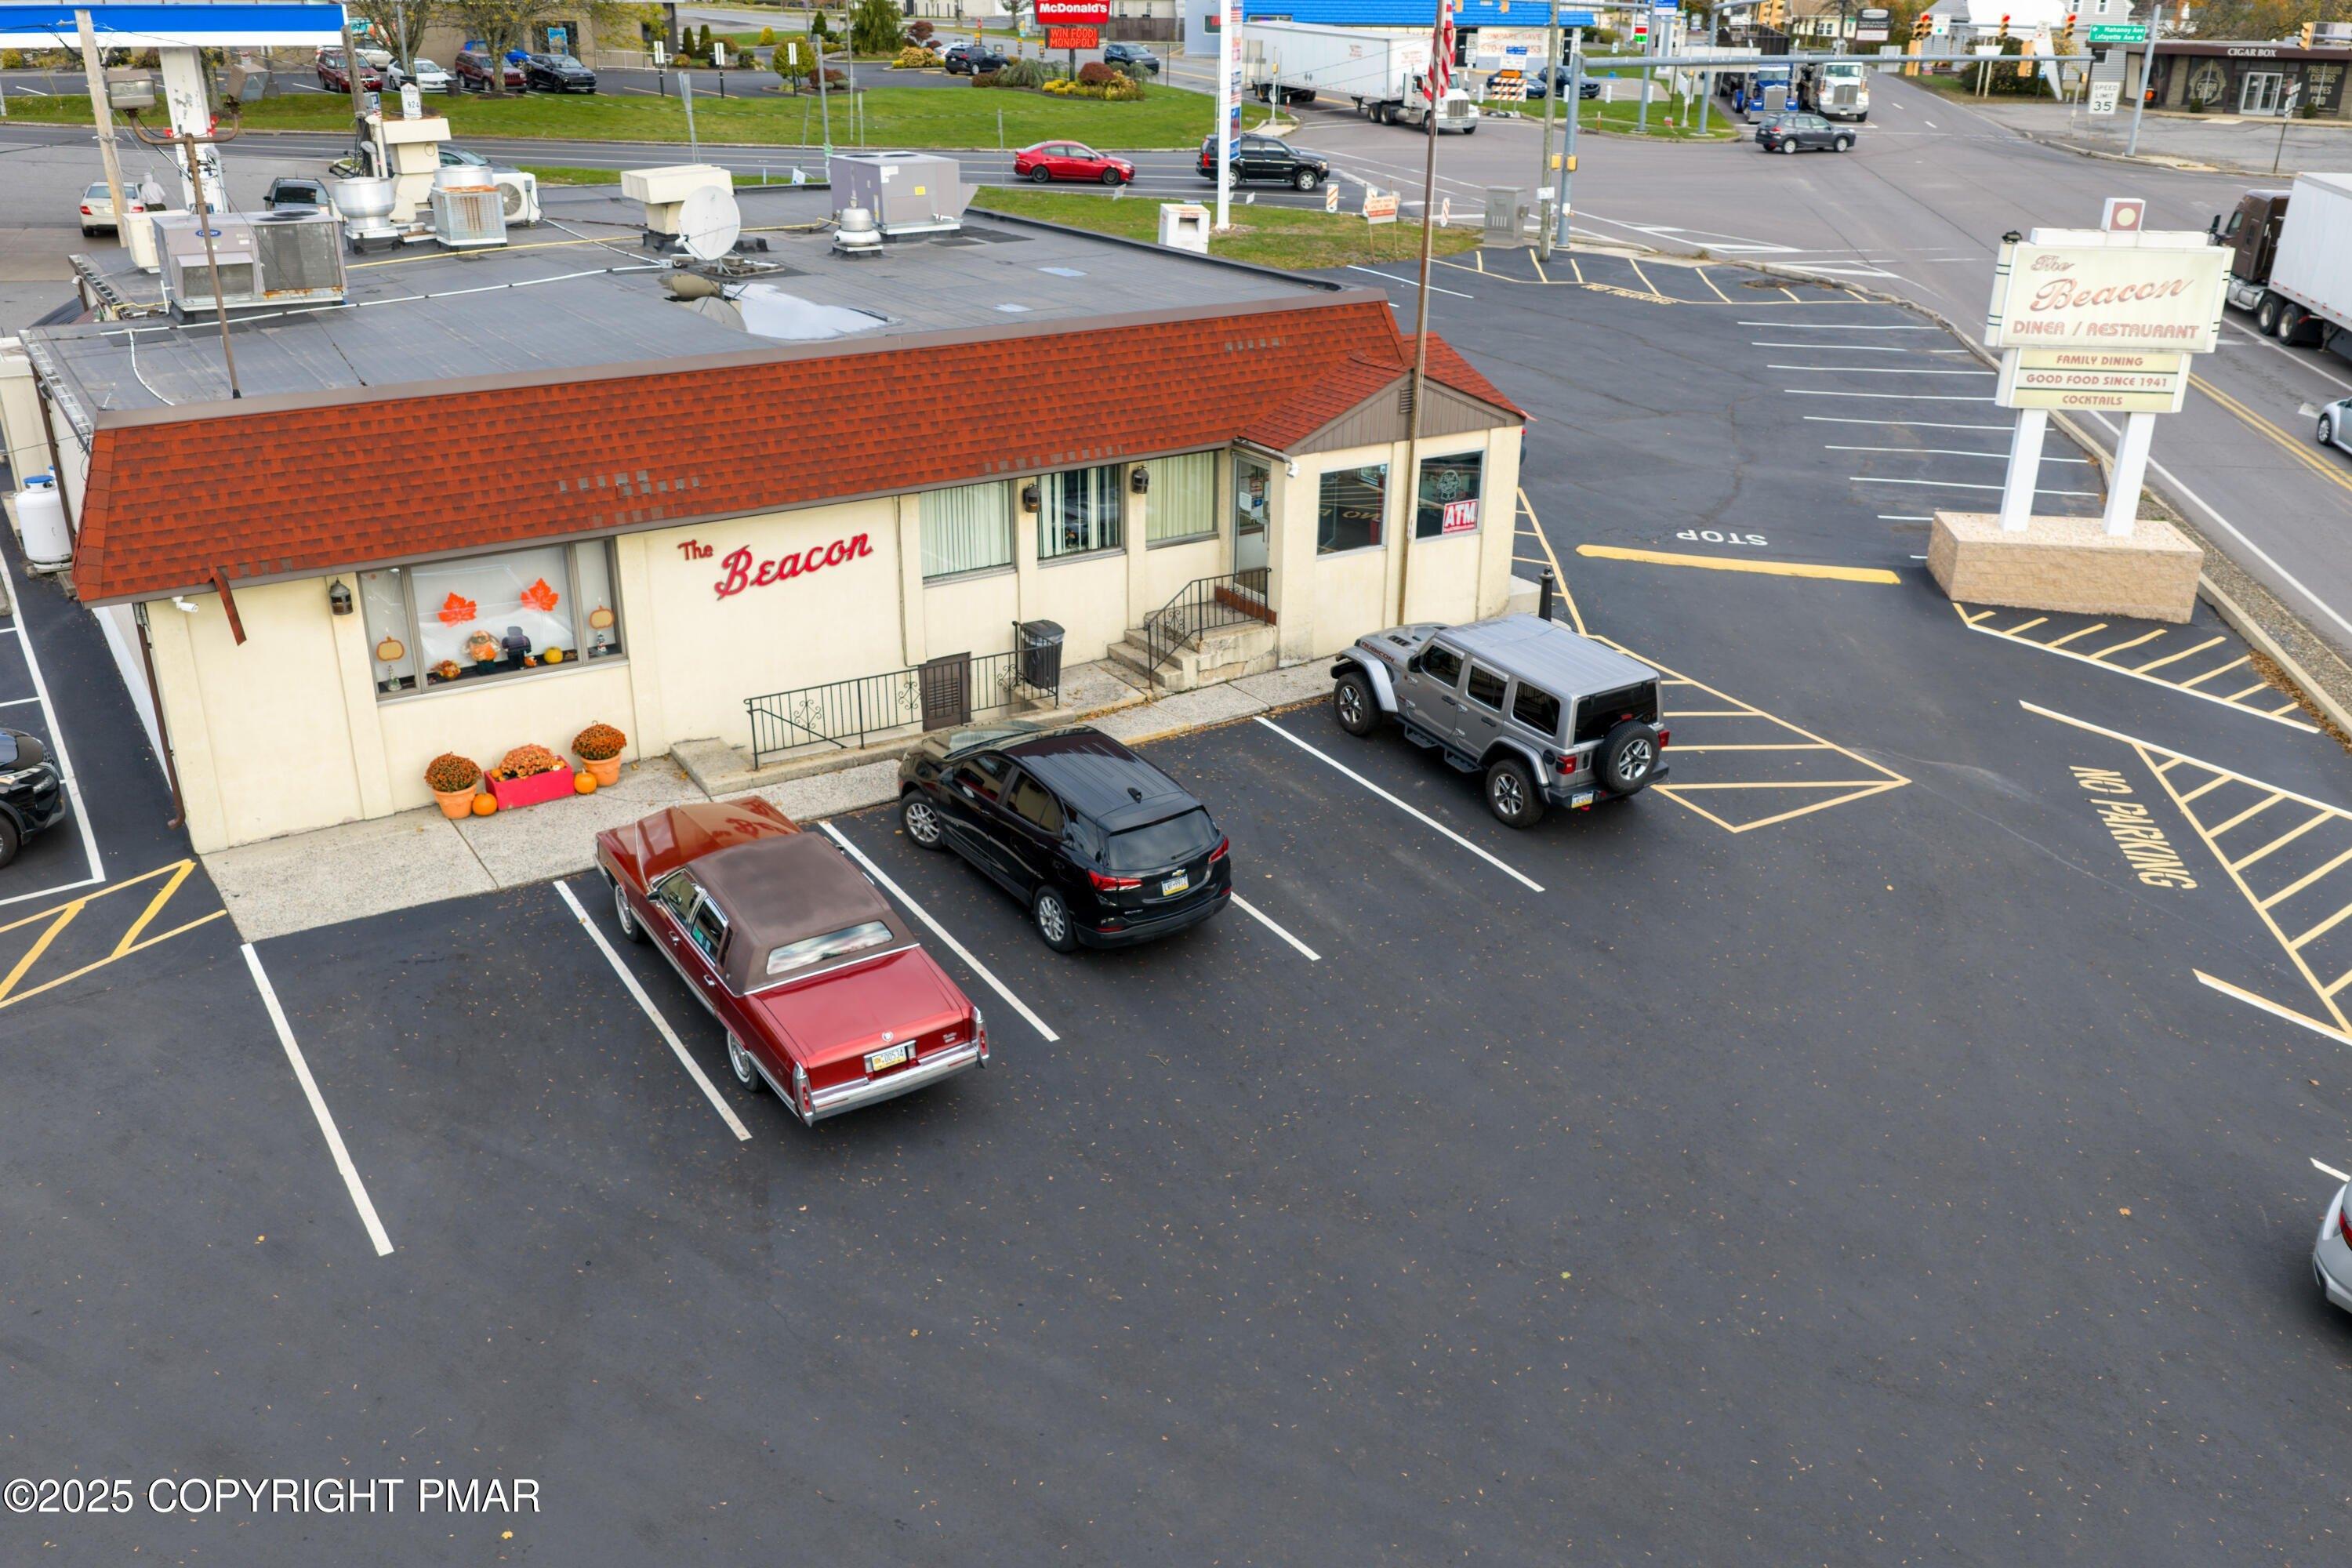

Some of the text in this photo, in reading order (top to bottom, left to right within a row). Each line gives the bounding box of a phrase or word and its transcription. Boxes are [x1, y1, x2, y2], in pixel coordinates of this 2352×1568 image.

[1039, 3, 1108, 13] McDonald's
[1051, 28, 1097, 38] WIN FOOD!
[1050, 38, 1098, 47] MONOPOLY
[2227, 48, 2277, 57] CIGAR BOX
[2093, 101, 2113, 111] 35
[2031, 255, 2075, 273] The
[2029, 278, 2194, 312] Beacon
[2013, 320, 2066, 336] DINER
[2086, 322, 2200, 339] RESTAURANT
[2056, 355, 2143, 366] FAMILY DINING
[2027, 374, 2168, 387] GOOD FOOD SINCE 1941
[2062, 394, 2123, 405] COCKTAILS
[1444, 502, 1477, 528] ATM
[1676, 529, 1769, 546] STOP
[677, 539, 713, 561] The
[713, 533, 874, 601] Beacon
[1361, 641, 1396, 662] RUBICON
[2069, 765, 2198, 889] NO PARKING
